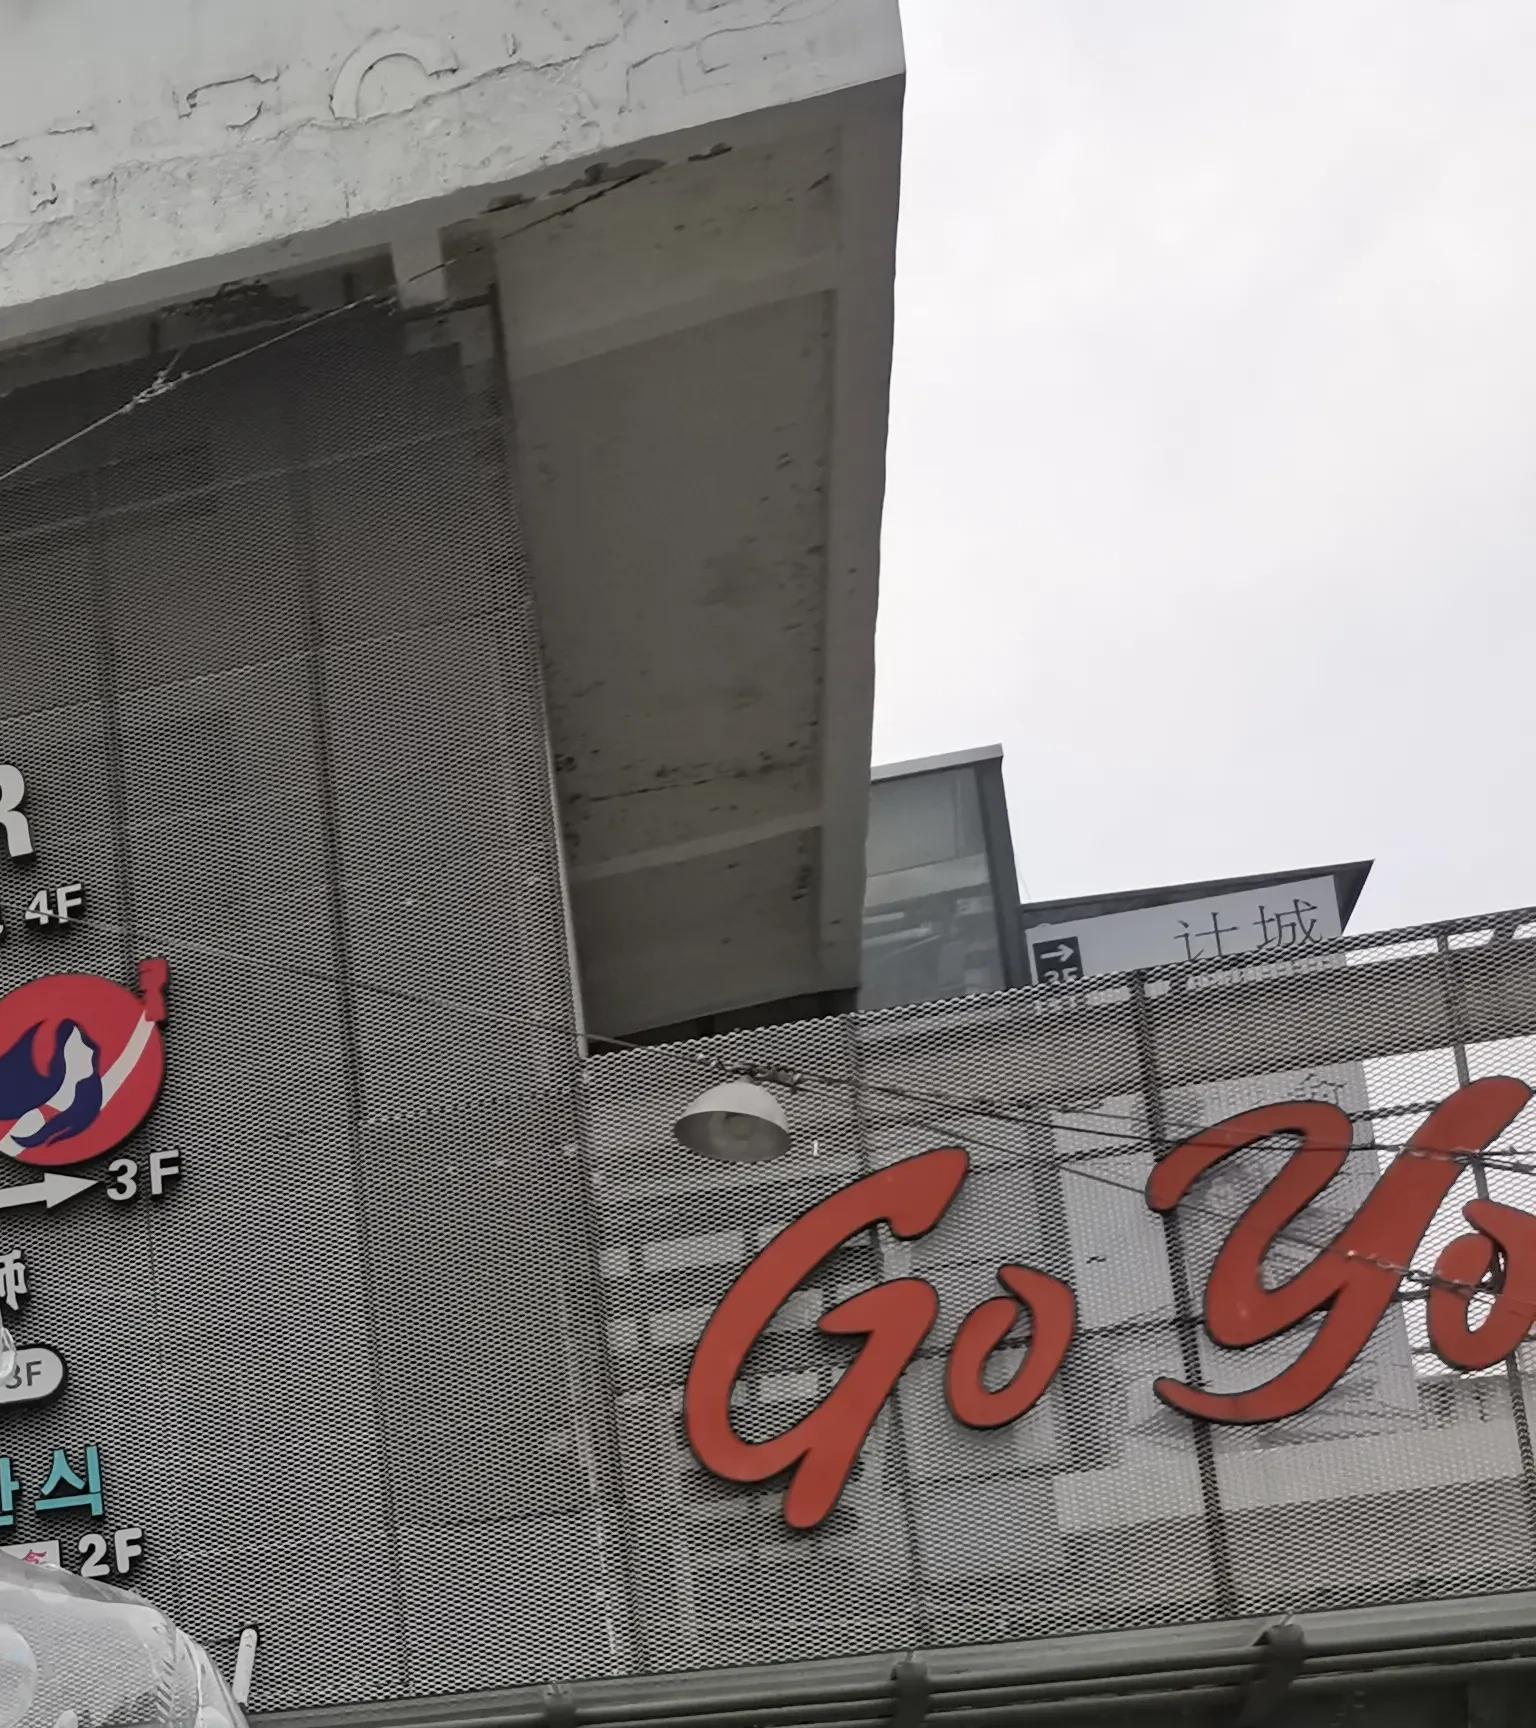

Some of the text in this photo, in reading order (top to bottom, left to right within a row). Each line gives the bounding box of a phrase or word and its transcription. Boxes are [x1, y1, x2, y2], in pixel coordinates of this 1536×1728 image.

[24, 883, 84, 926] 4F
[105, 1150, 181, 1202] 3F
[684, 1147, 1077, 1530] Go
[76, 1527, 143, 1579] 2F
